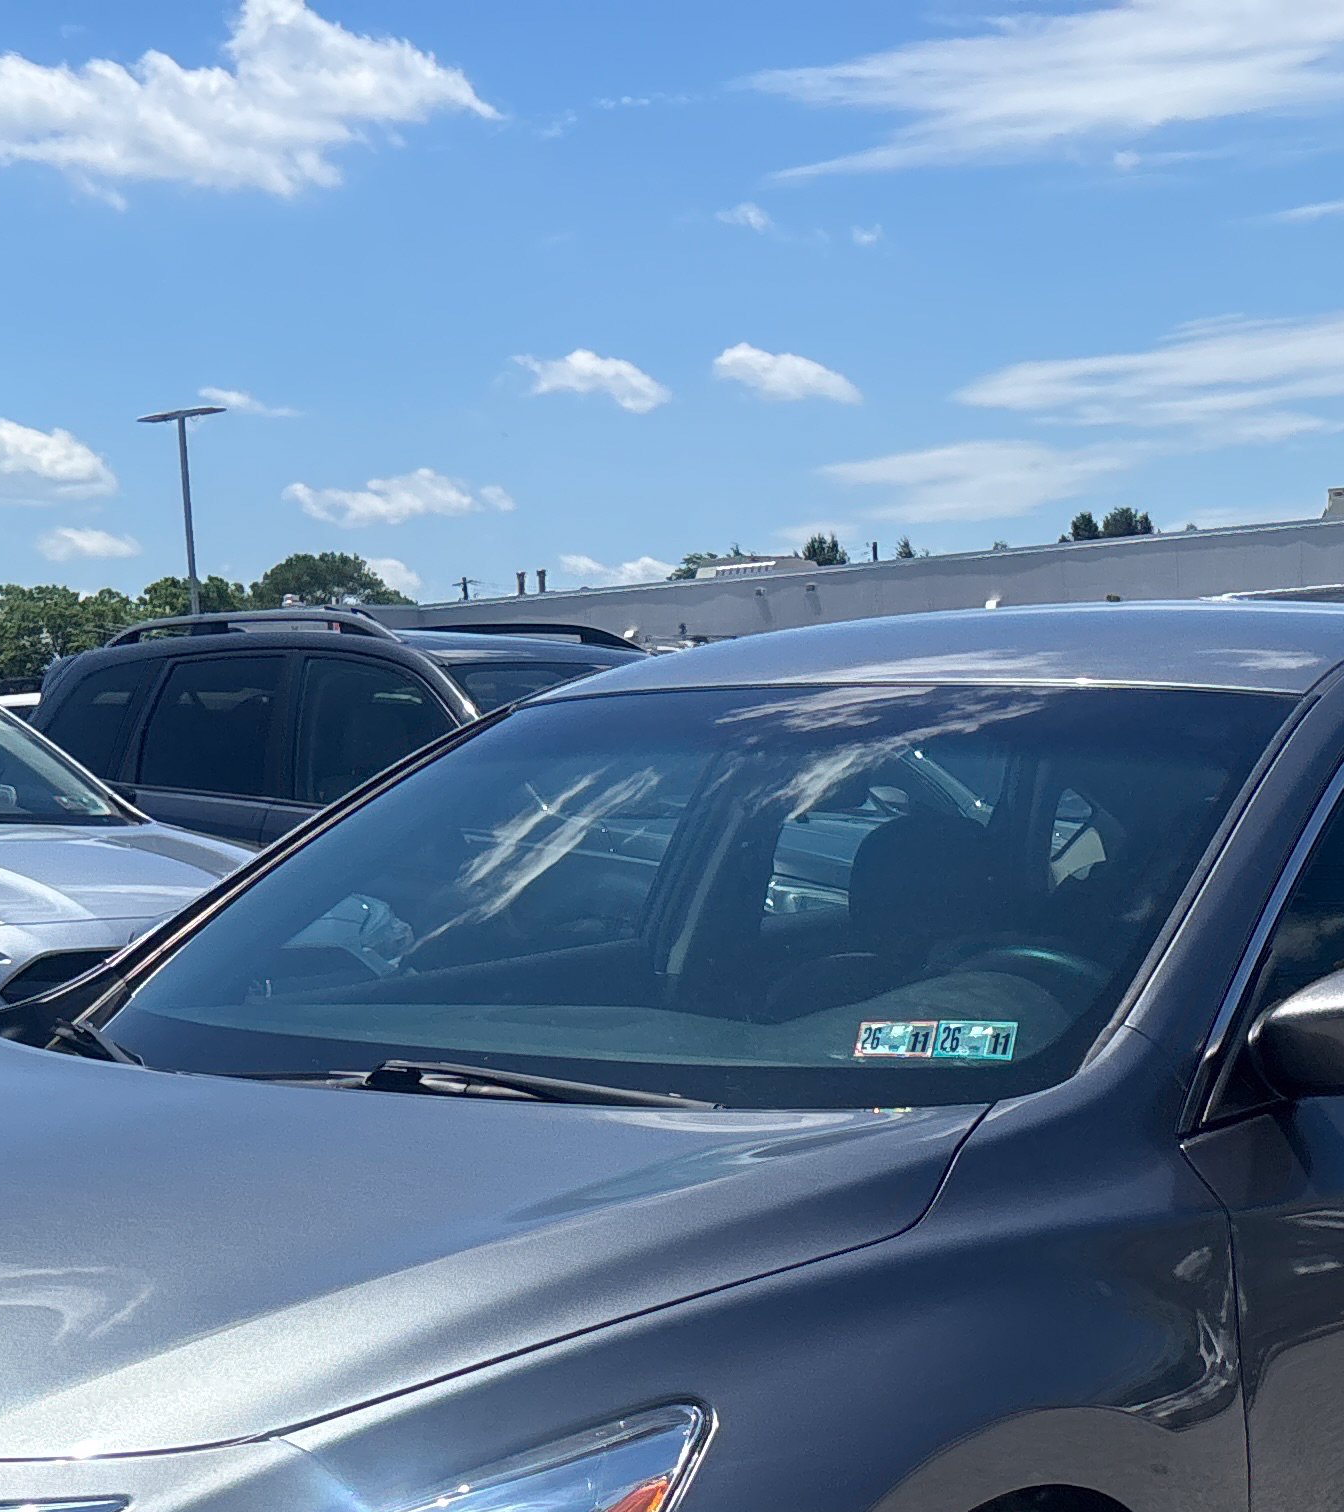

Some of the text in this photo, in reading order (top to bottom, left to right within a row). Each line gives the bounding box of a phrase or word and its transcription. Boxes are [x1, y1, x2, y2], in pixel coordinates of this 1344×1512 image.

[861, 1026, 930, 1053] 26 11
[940, 1026, 1011, 1055] 26 11
